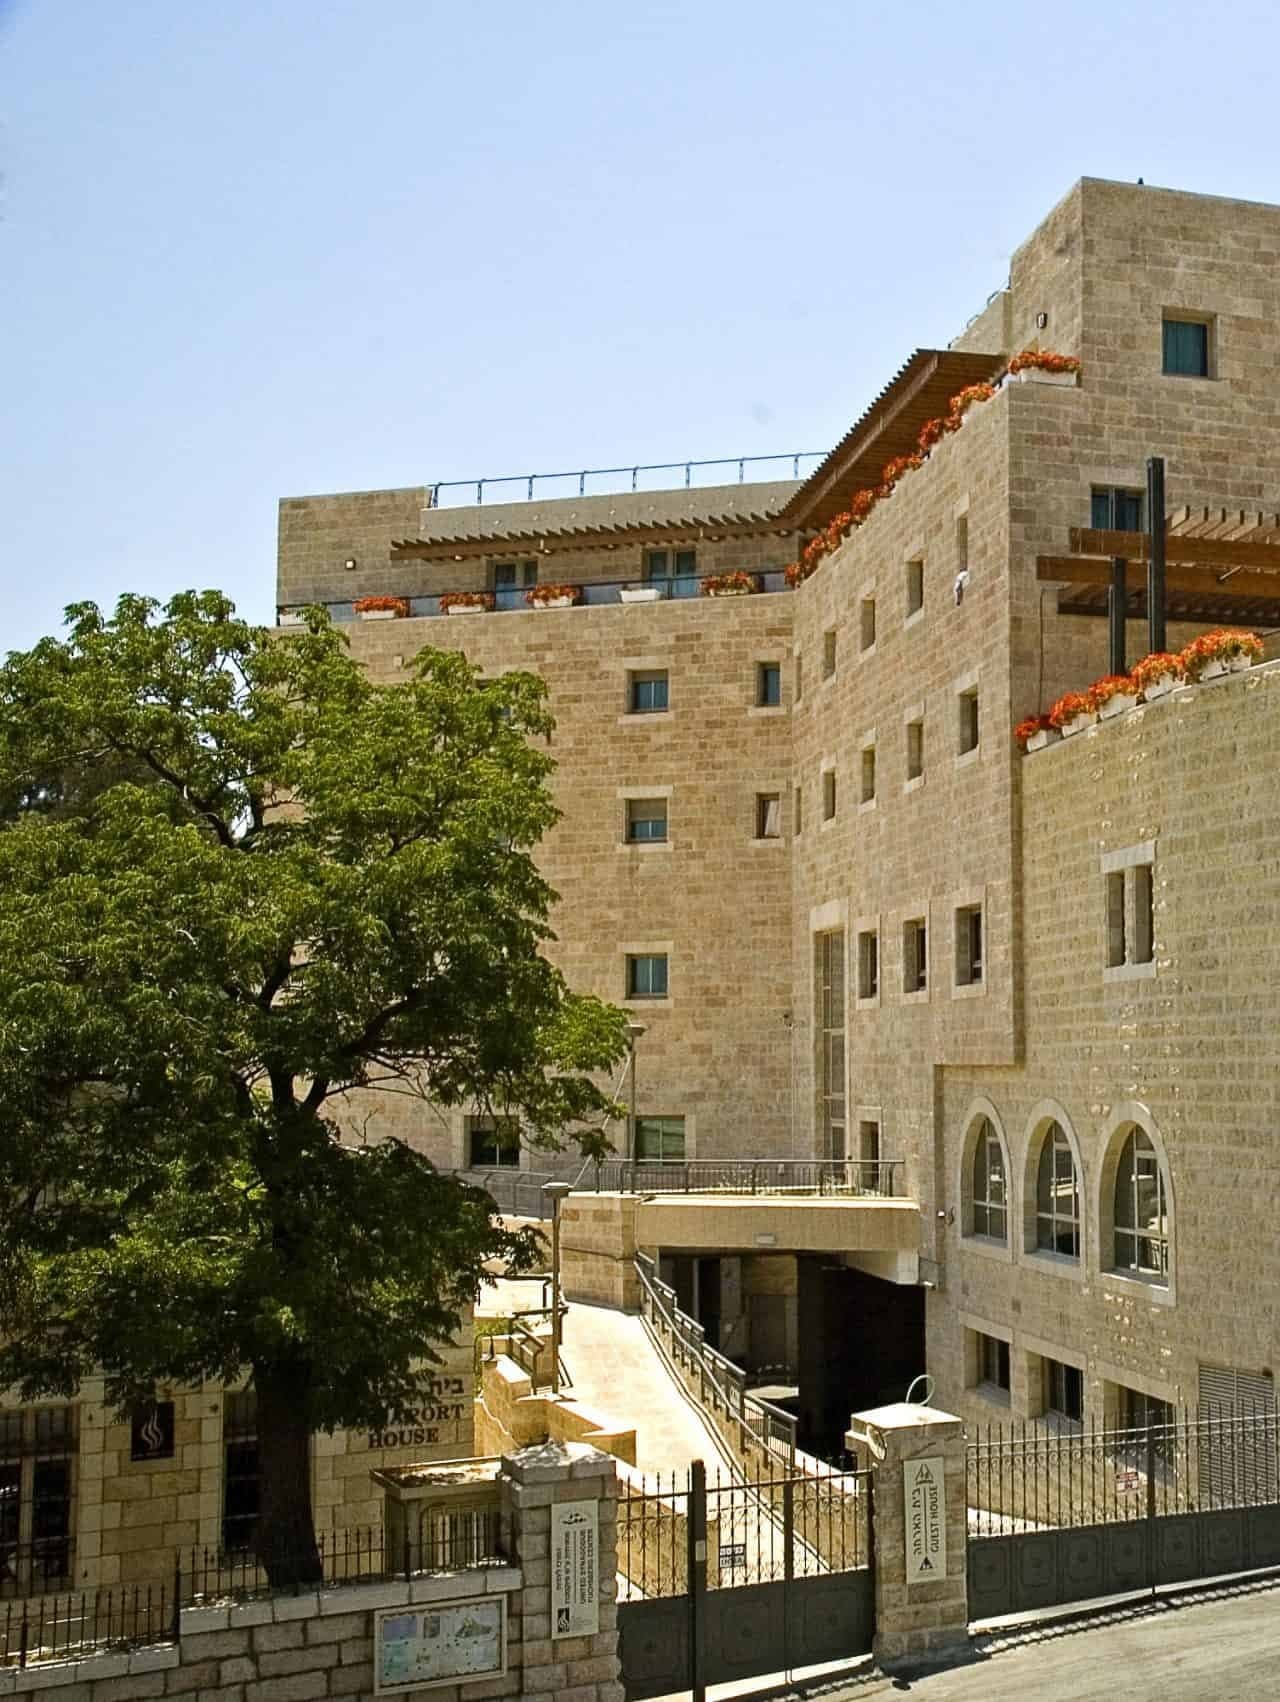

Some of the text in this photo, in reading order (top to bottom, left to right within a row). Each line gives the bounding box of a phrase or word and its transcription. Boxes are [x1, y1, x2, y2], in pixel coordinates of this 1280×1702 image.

[368, 1426, 440, 1449] HOUSE
[912, 1487, 922, 1556] בית הארחה
[928, 1485, 940, 1553] GUEST HOUSE
